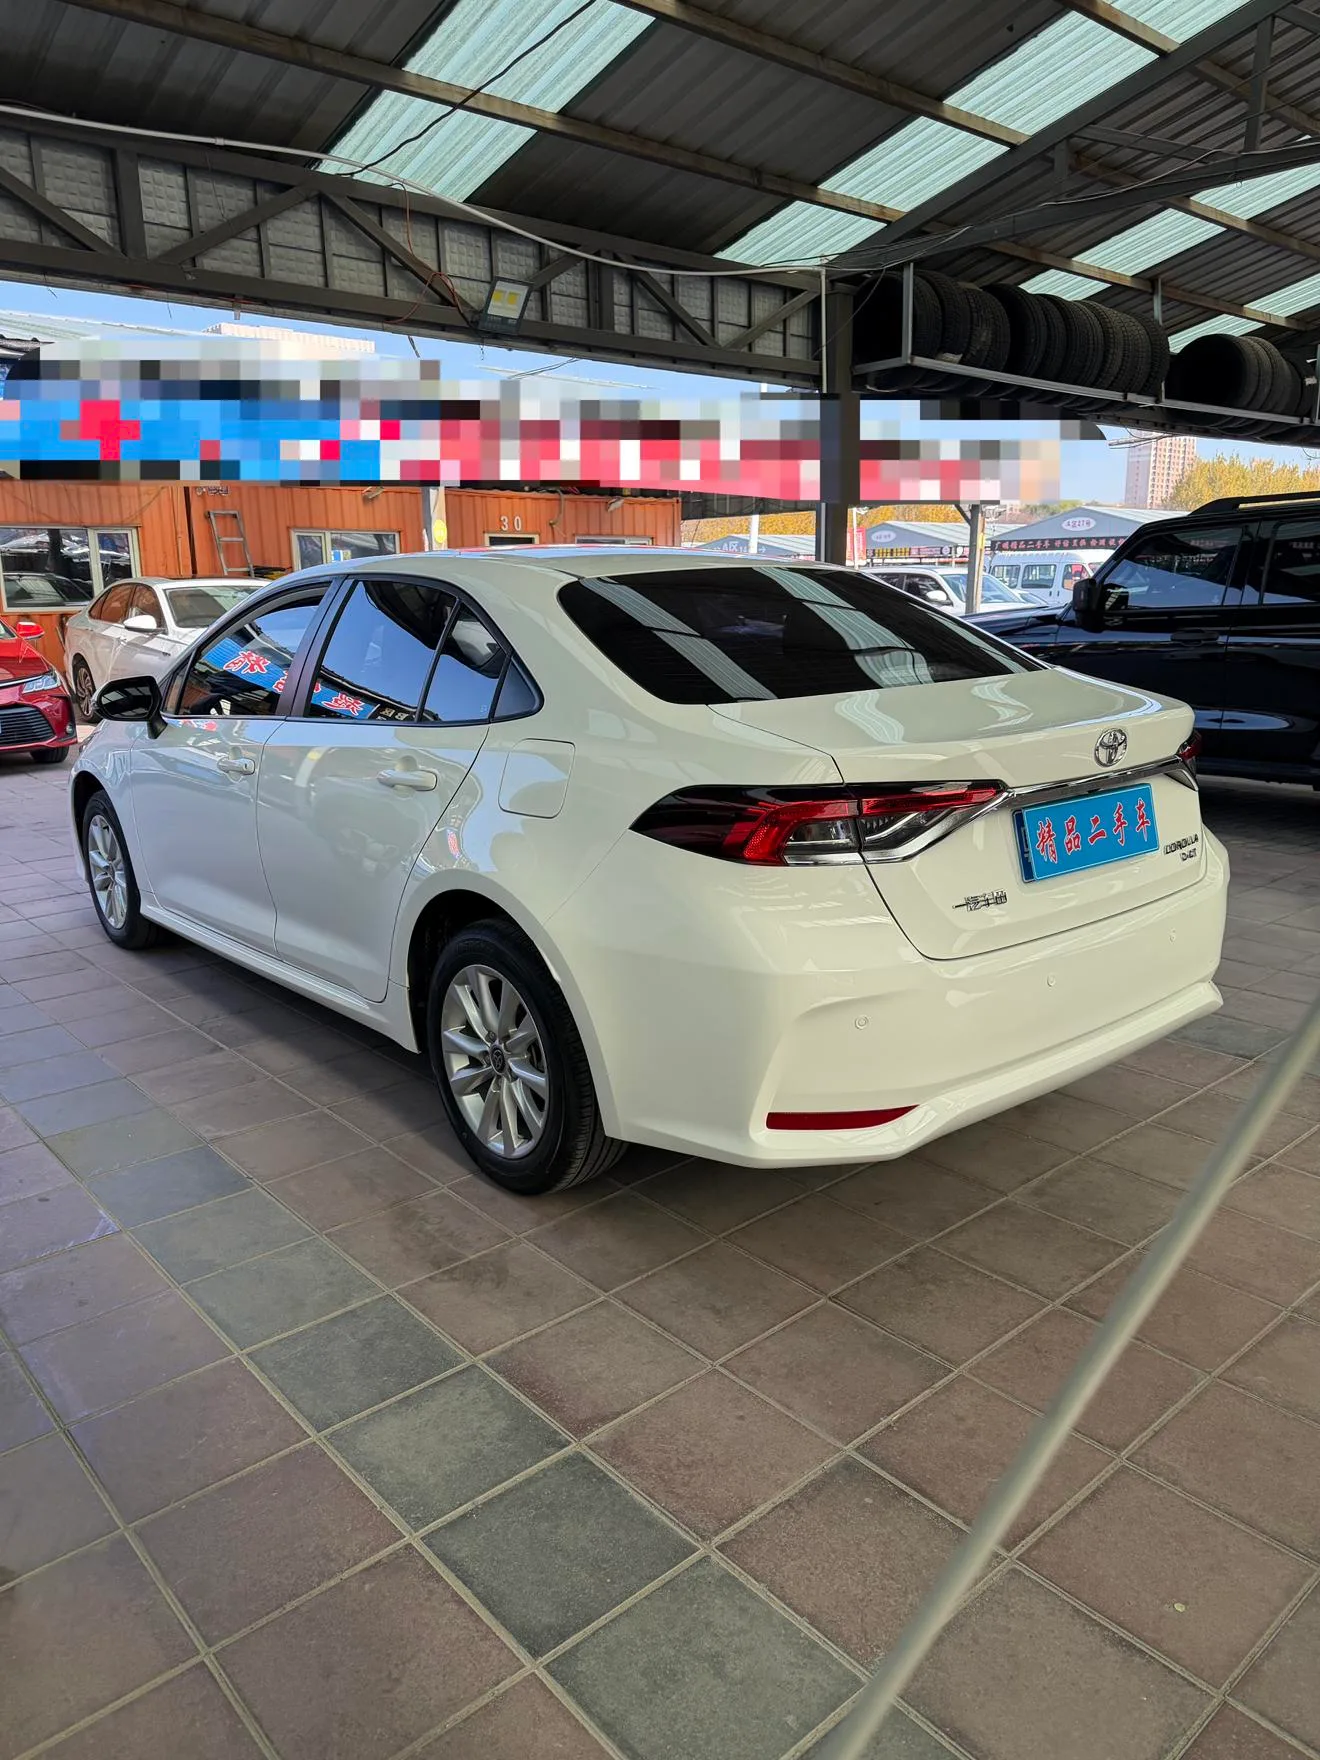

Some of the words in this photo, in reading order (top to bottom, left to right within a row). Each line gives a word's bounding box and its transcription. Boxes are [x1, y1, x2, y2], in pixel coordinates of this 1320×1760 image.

[501, 516, 522, 531] 30
[1035, 797, 1151, 864] 精品二手车
[1163, 833, 1199, 855] COROLLA
